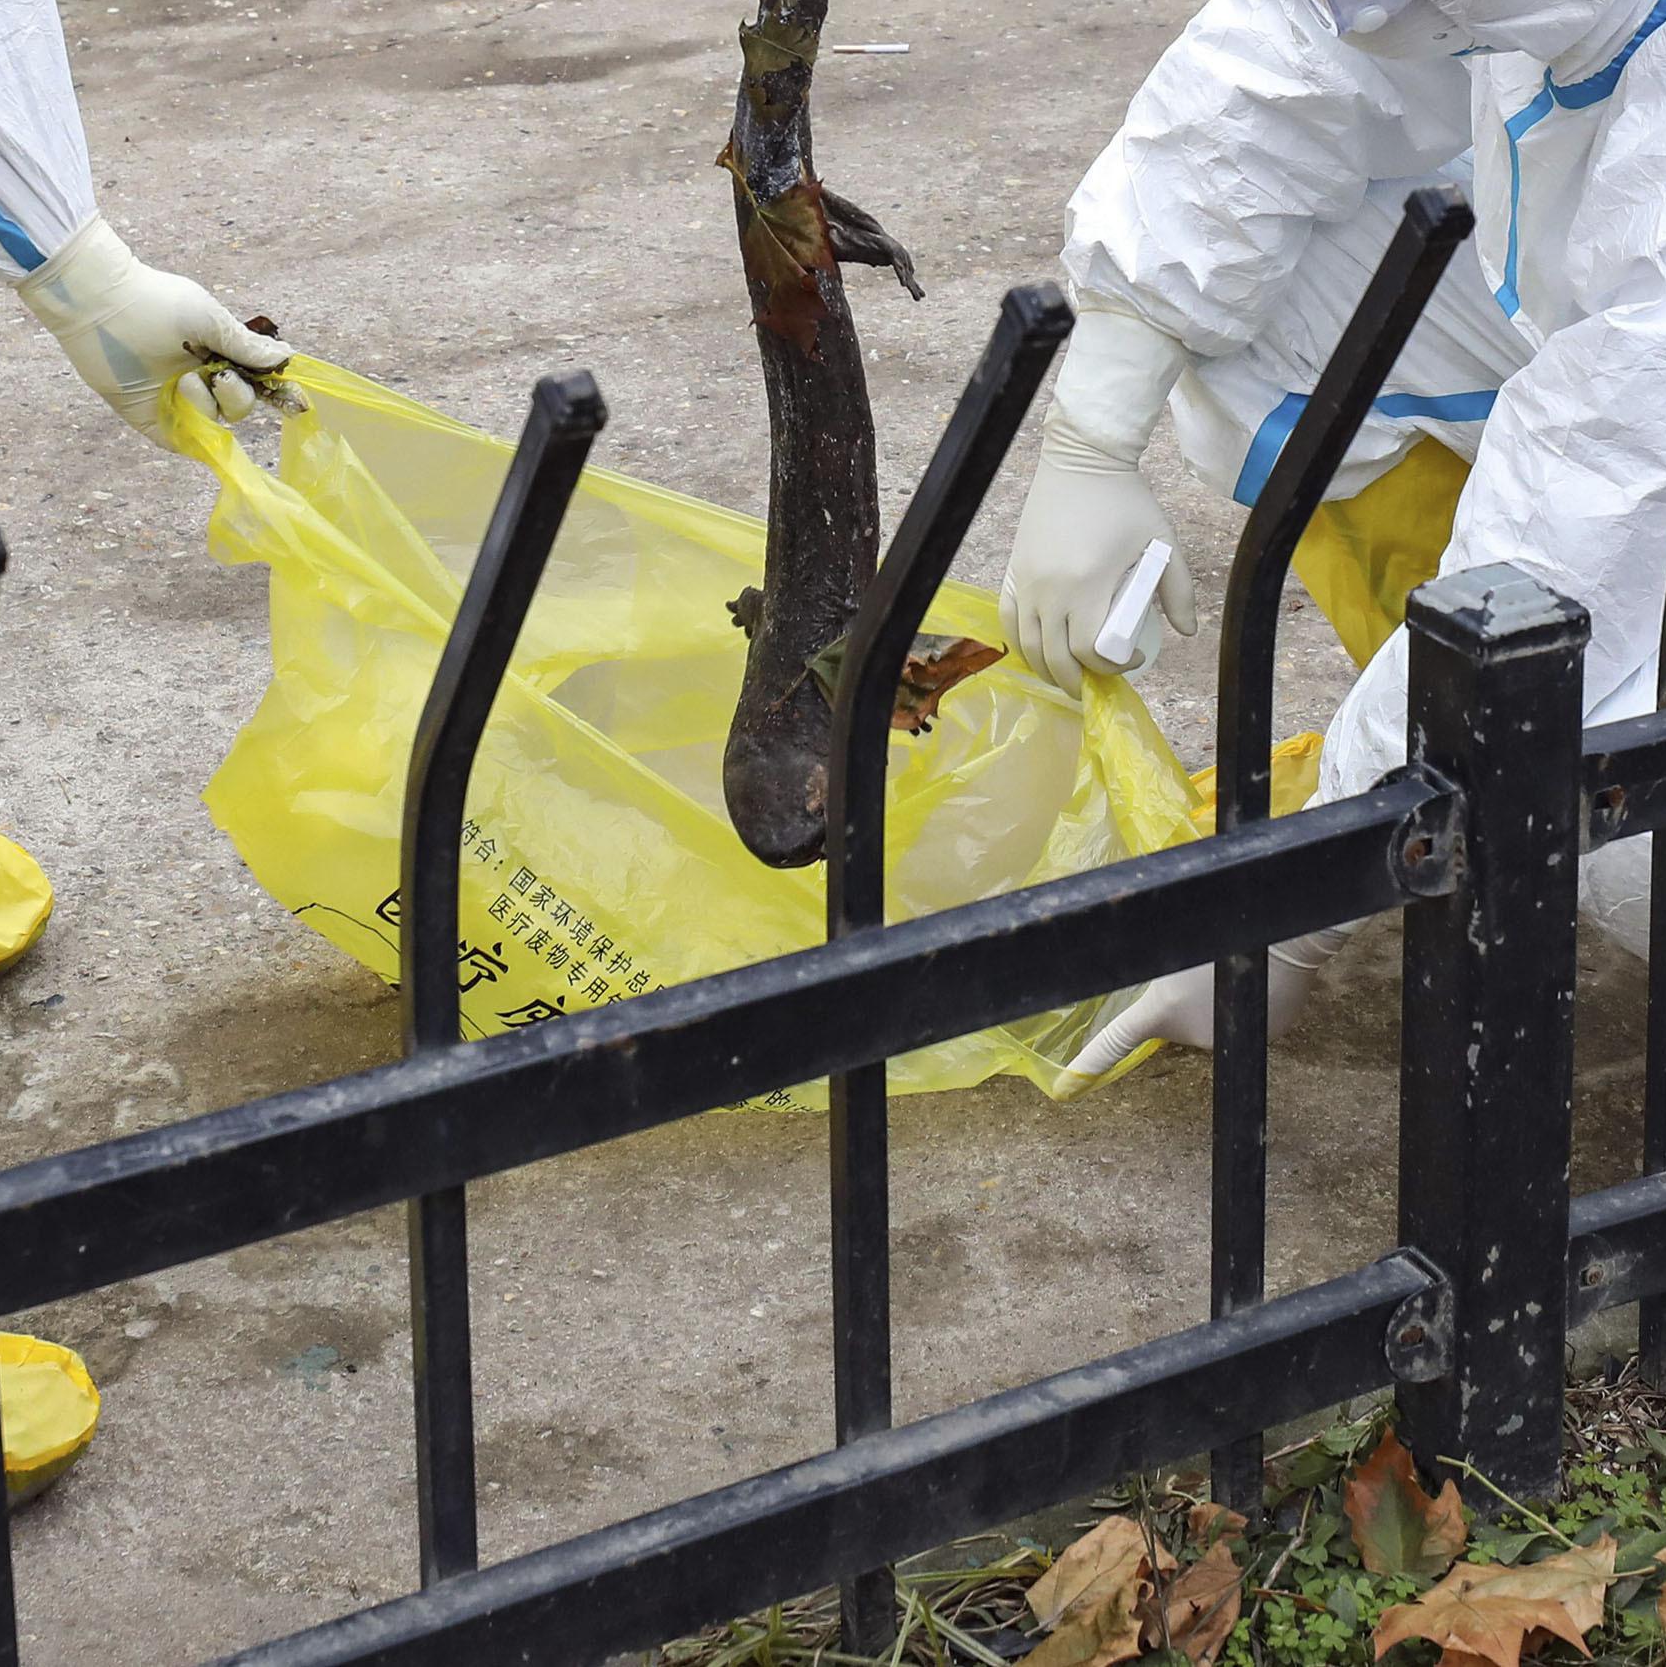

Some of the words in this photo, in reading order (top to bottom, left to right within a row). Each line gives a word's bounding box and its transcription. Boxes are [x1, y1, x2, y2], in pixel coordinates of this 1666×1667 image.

[460, 820, 664, 994] 符合：国家环境保护总
